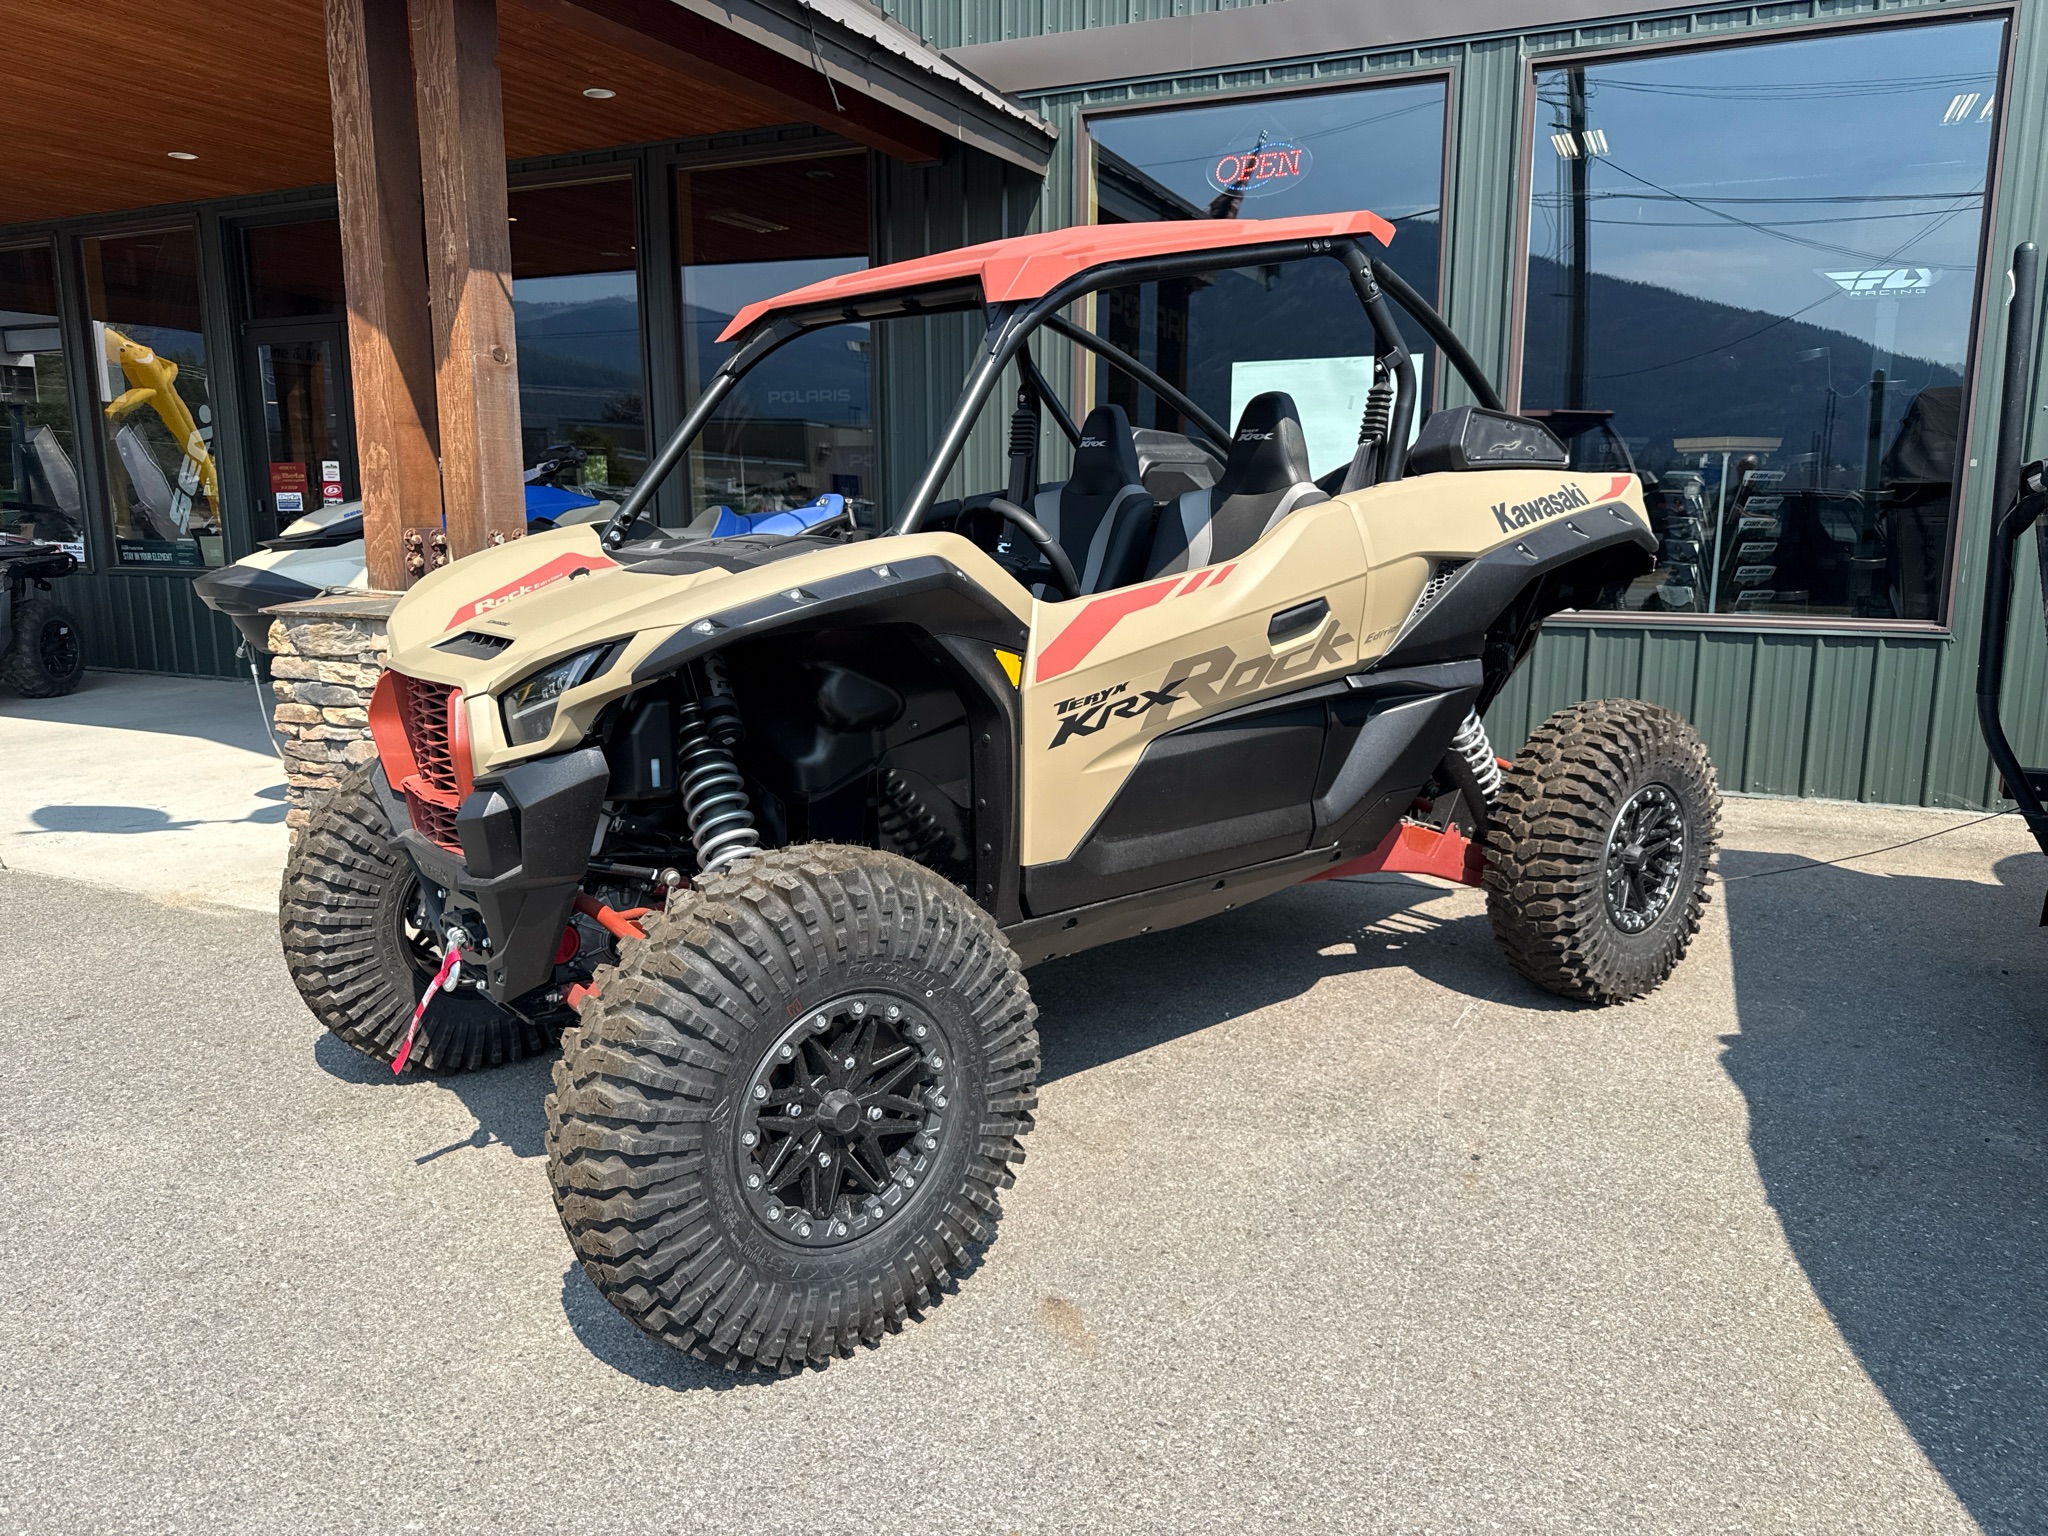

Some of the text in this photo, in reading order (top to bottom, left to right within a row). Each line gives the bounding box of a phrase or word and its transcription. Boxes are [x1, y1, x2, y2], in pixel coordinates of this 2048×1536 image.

[1215, 149, 1302, 183] OPEN
[1824, 268, 1933, 290] FLY
[1850, 288, 1927, 297] RACING
[767, 388, 852, 404] POLARIS
[1080, 440, 1107, 448] KRX
[1237, 433, 1276, 442] KRX
[1491, 482, 1590, 534] Kawasaki
[152, 552, 173, 561] ELEMENT
[474, 586, 534, 615] Rock
[1048, 677, 1189, 750] KRX
[1141, 619, 1355, 731] Rock
[1054, 681, 1130, 715] TERYX
